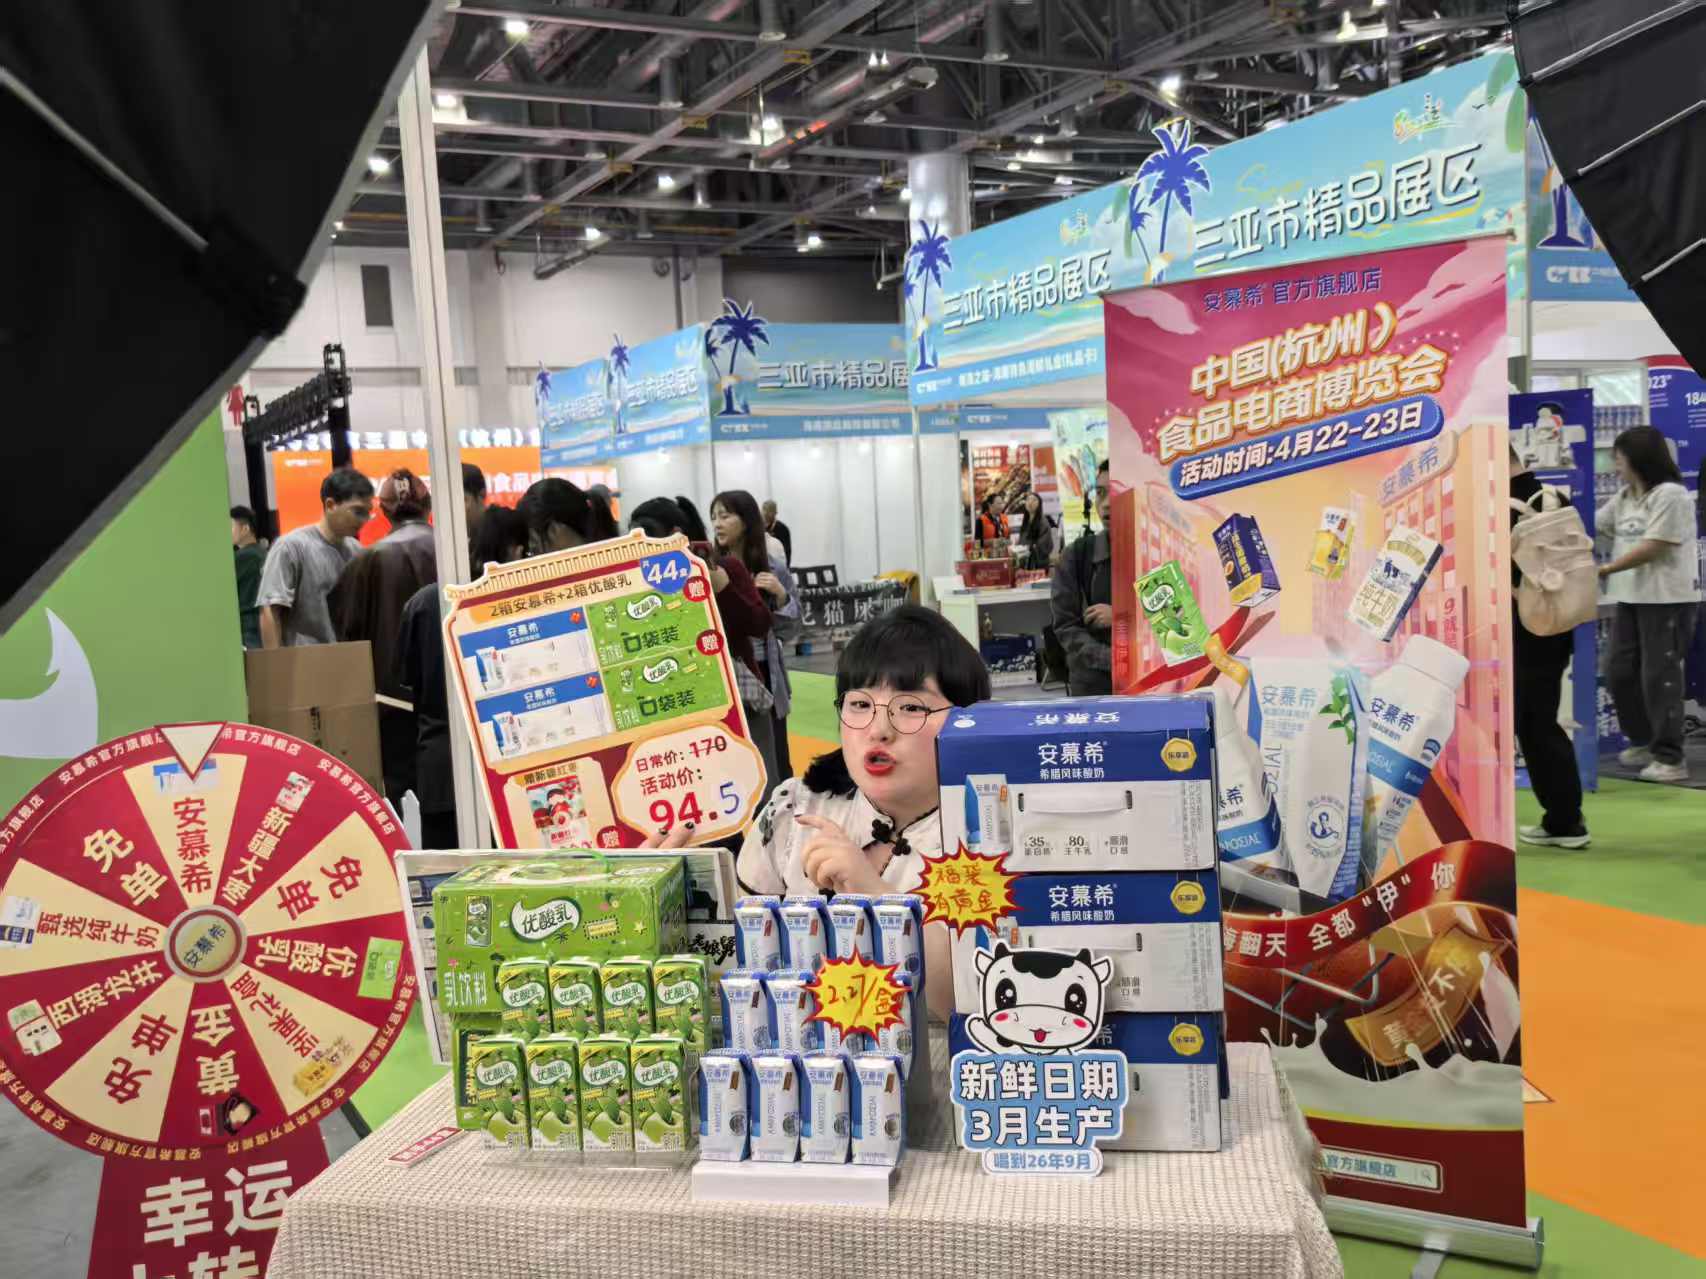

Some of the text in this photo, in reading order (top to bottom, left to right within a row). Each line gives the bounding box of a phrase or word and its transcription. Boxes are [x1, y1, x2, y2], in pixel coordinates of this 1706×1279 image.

[1194, 143, 1481, 269] 三亚市精品展区
[944, 250, 1112, 331] 三亚市精品展区
[1272, 267, 1382, 304] 官方旗舰店
[1191, 302, 1399, 399] 中国(杭州)
[1157, 344, 1448, 464] 食品电商博览会
[1180, 401, 1423, 487] 活动时间:4月22-23日
[490, 573, 632, 618] 2箱安慕希+2箱优酸乳
[1370, 697, 1417, 732] 安慕希
[635, 749, 685, 773] 日常价:
[640, 767, 703, 796] 活动价:
[1038, 741, 1104, 766] 安慕希
[1039, 767, 1106, 780] 希腊风味酸奶
[82, 828, 168, 907] 免单
[173, 797, 214, 894] 安慕希
[276, 855, 364, 922] 免单
[1049, 884, 1115, 908] 安慕希
[1050, 910, 1115, 922] 希腊风味酸奶
[1307, 909, 1357, 951] 全都
[1431, 862, 1457, 891] 你
[521, 903, 573, 935] 优酸乳
[254, 935, 359, 978] 优酸乳
[46, 959, 164, 1030] 西湖龙井
[103, 1013, 178, 1104] 免单
[191, 1003, 241, 1097] 黄金
[960, 1059, 1119, 1100] 新鲜日期
[970, 1105, 1113, 1147] 3月生产
[140, 1159, 293, 1248] 幸运
